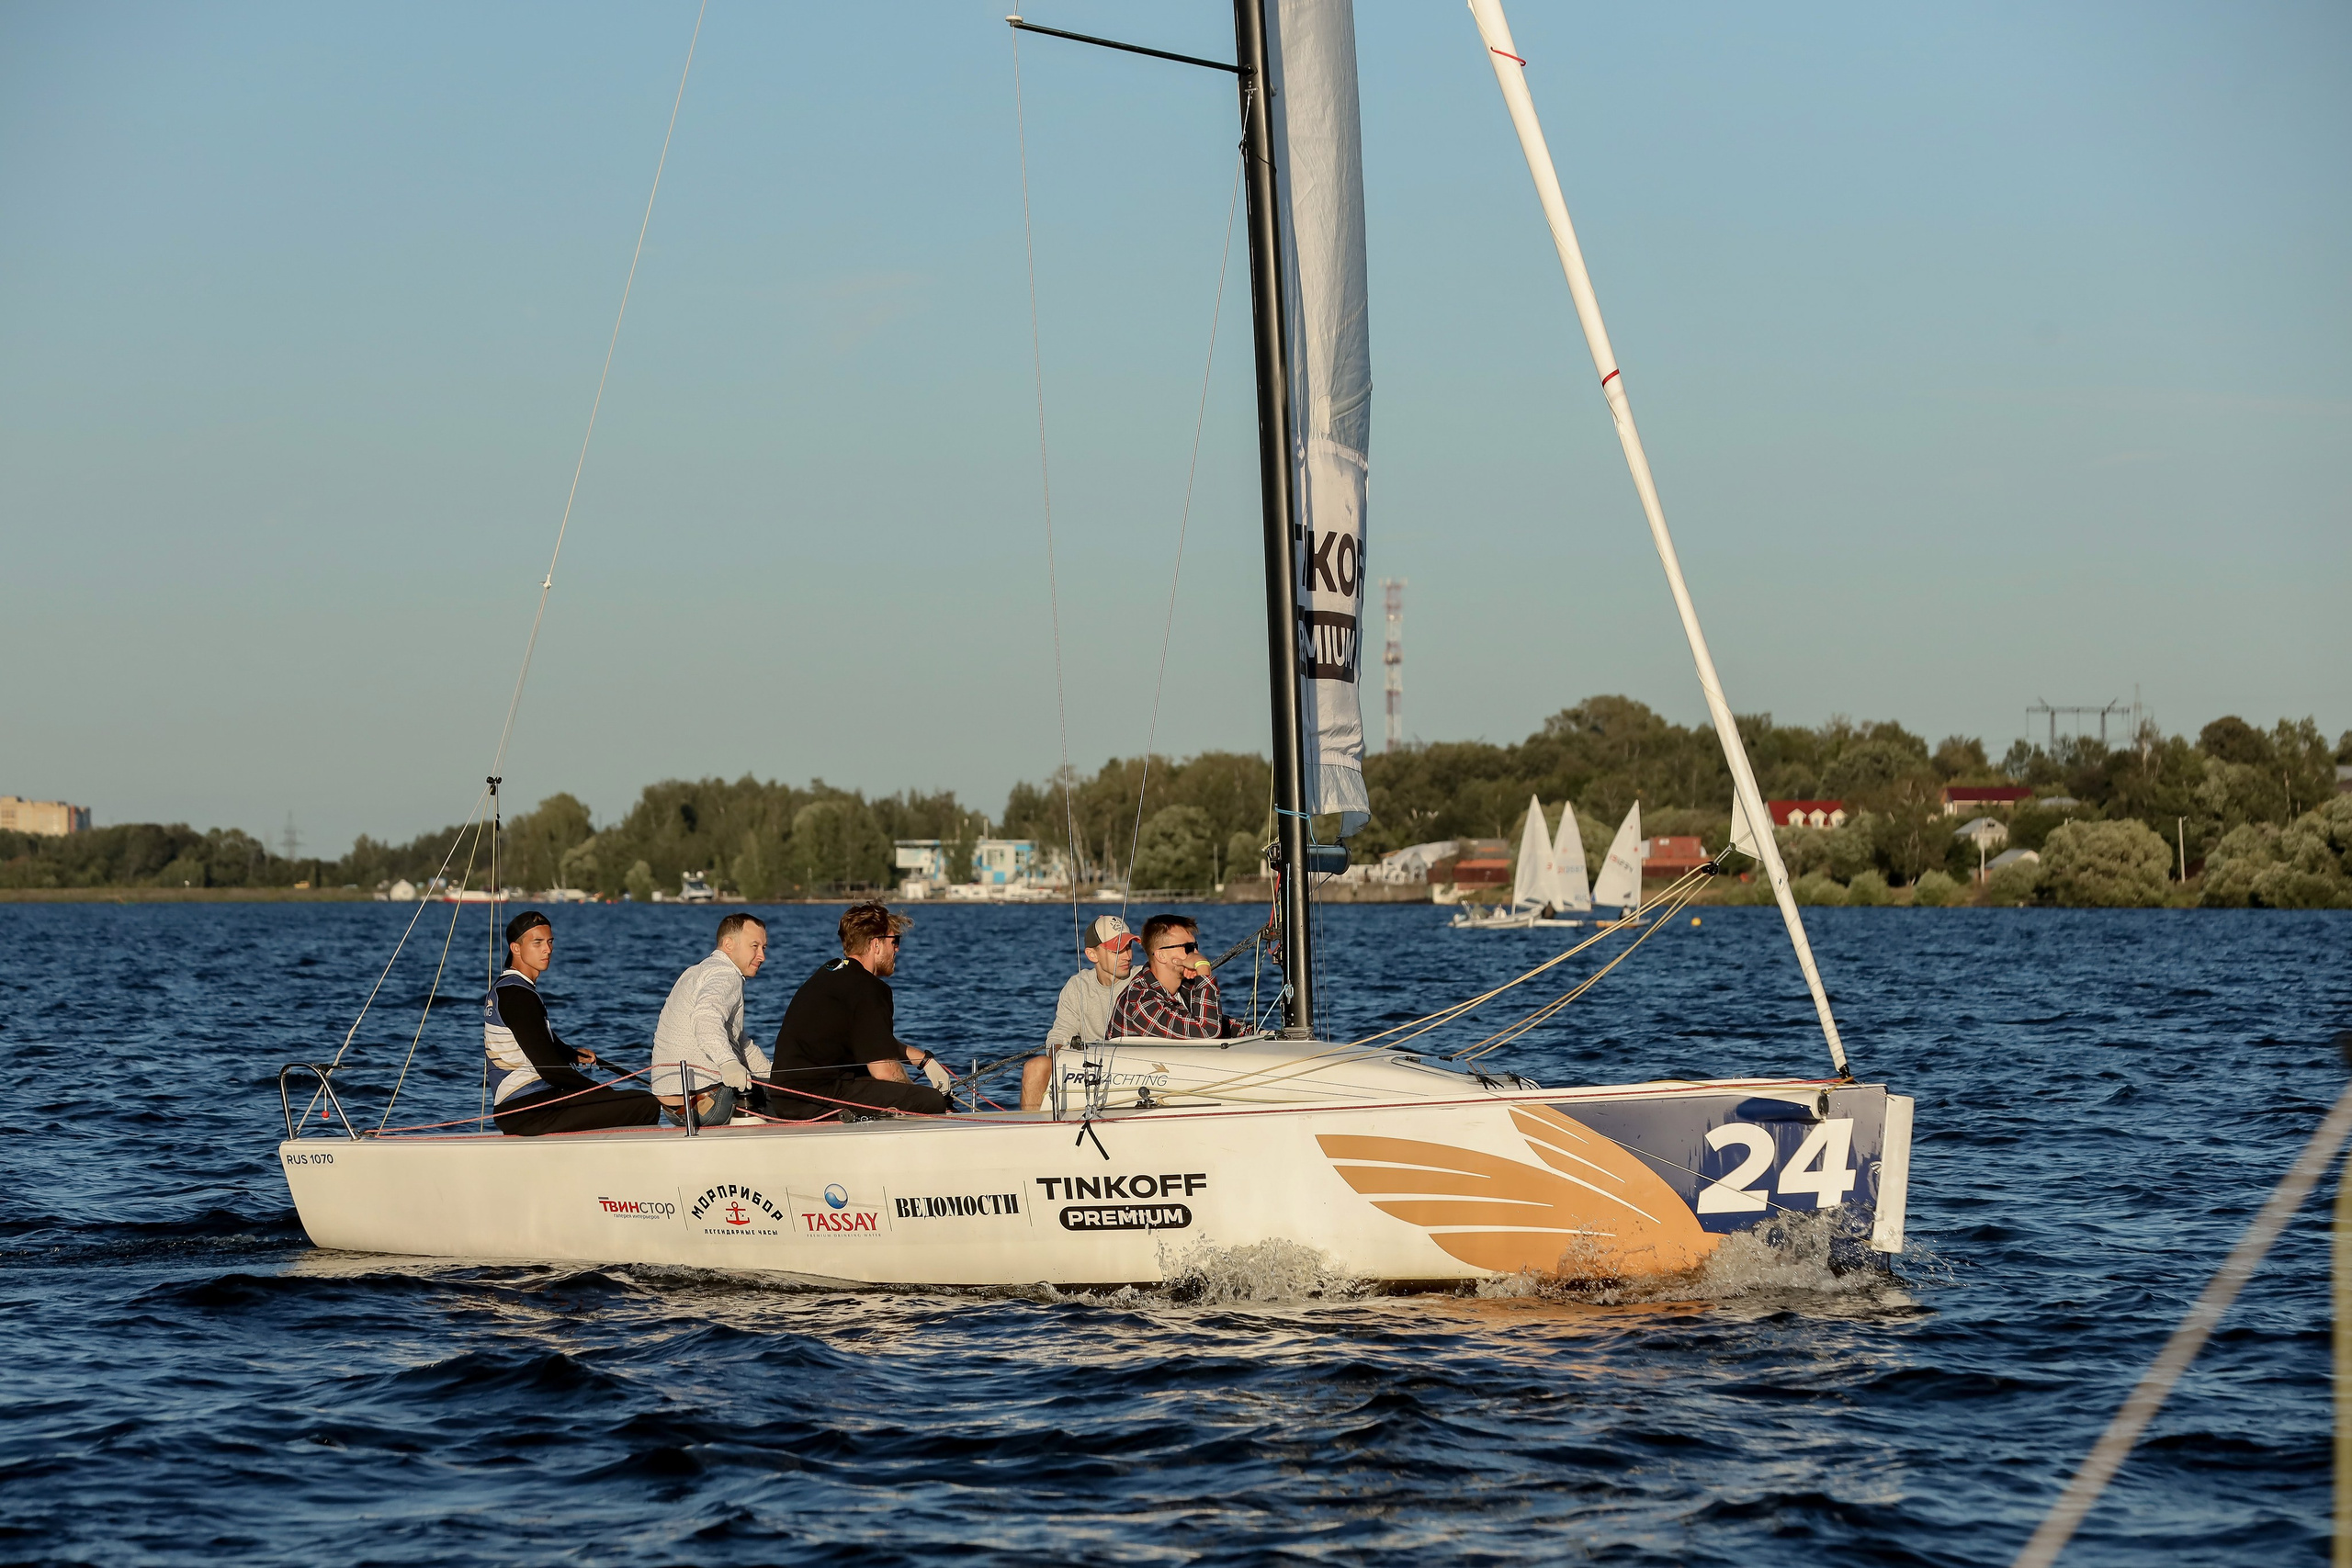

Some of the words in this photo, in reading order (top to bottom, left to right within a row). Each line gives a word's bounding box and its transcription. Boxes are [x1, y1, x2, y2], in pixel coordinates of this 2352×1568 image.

[286, 1154, 308, 1165] RUS
[310, 1154, 334, 1164] 1070
[1697, 1118, 1856, 1214] 24
[1035, 1173, 1207, 1201] TINKOFF
[691, 1185, 784, 1221] МОРПРИБОР
[894, 1194, 1020, 1220] ВЕДОМОСТИ
[801, 1213, 878, 1232] TASSAY
[1067, 1208, 1183, 1226] PREMIUM
